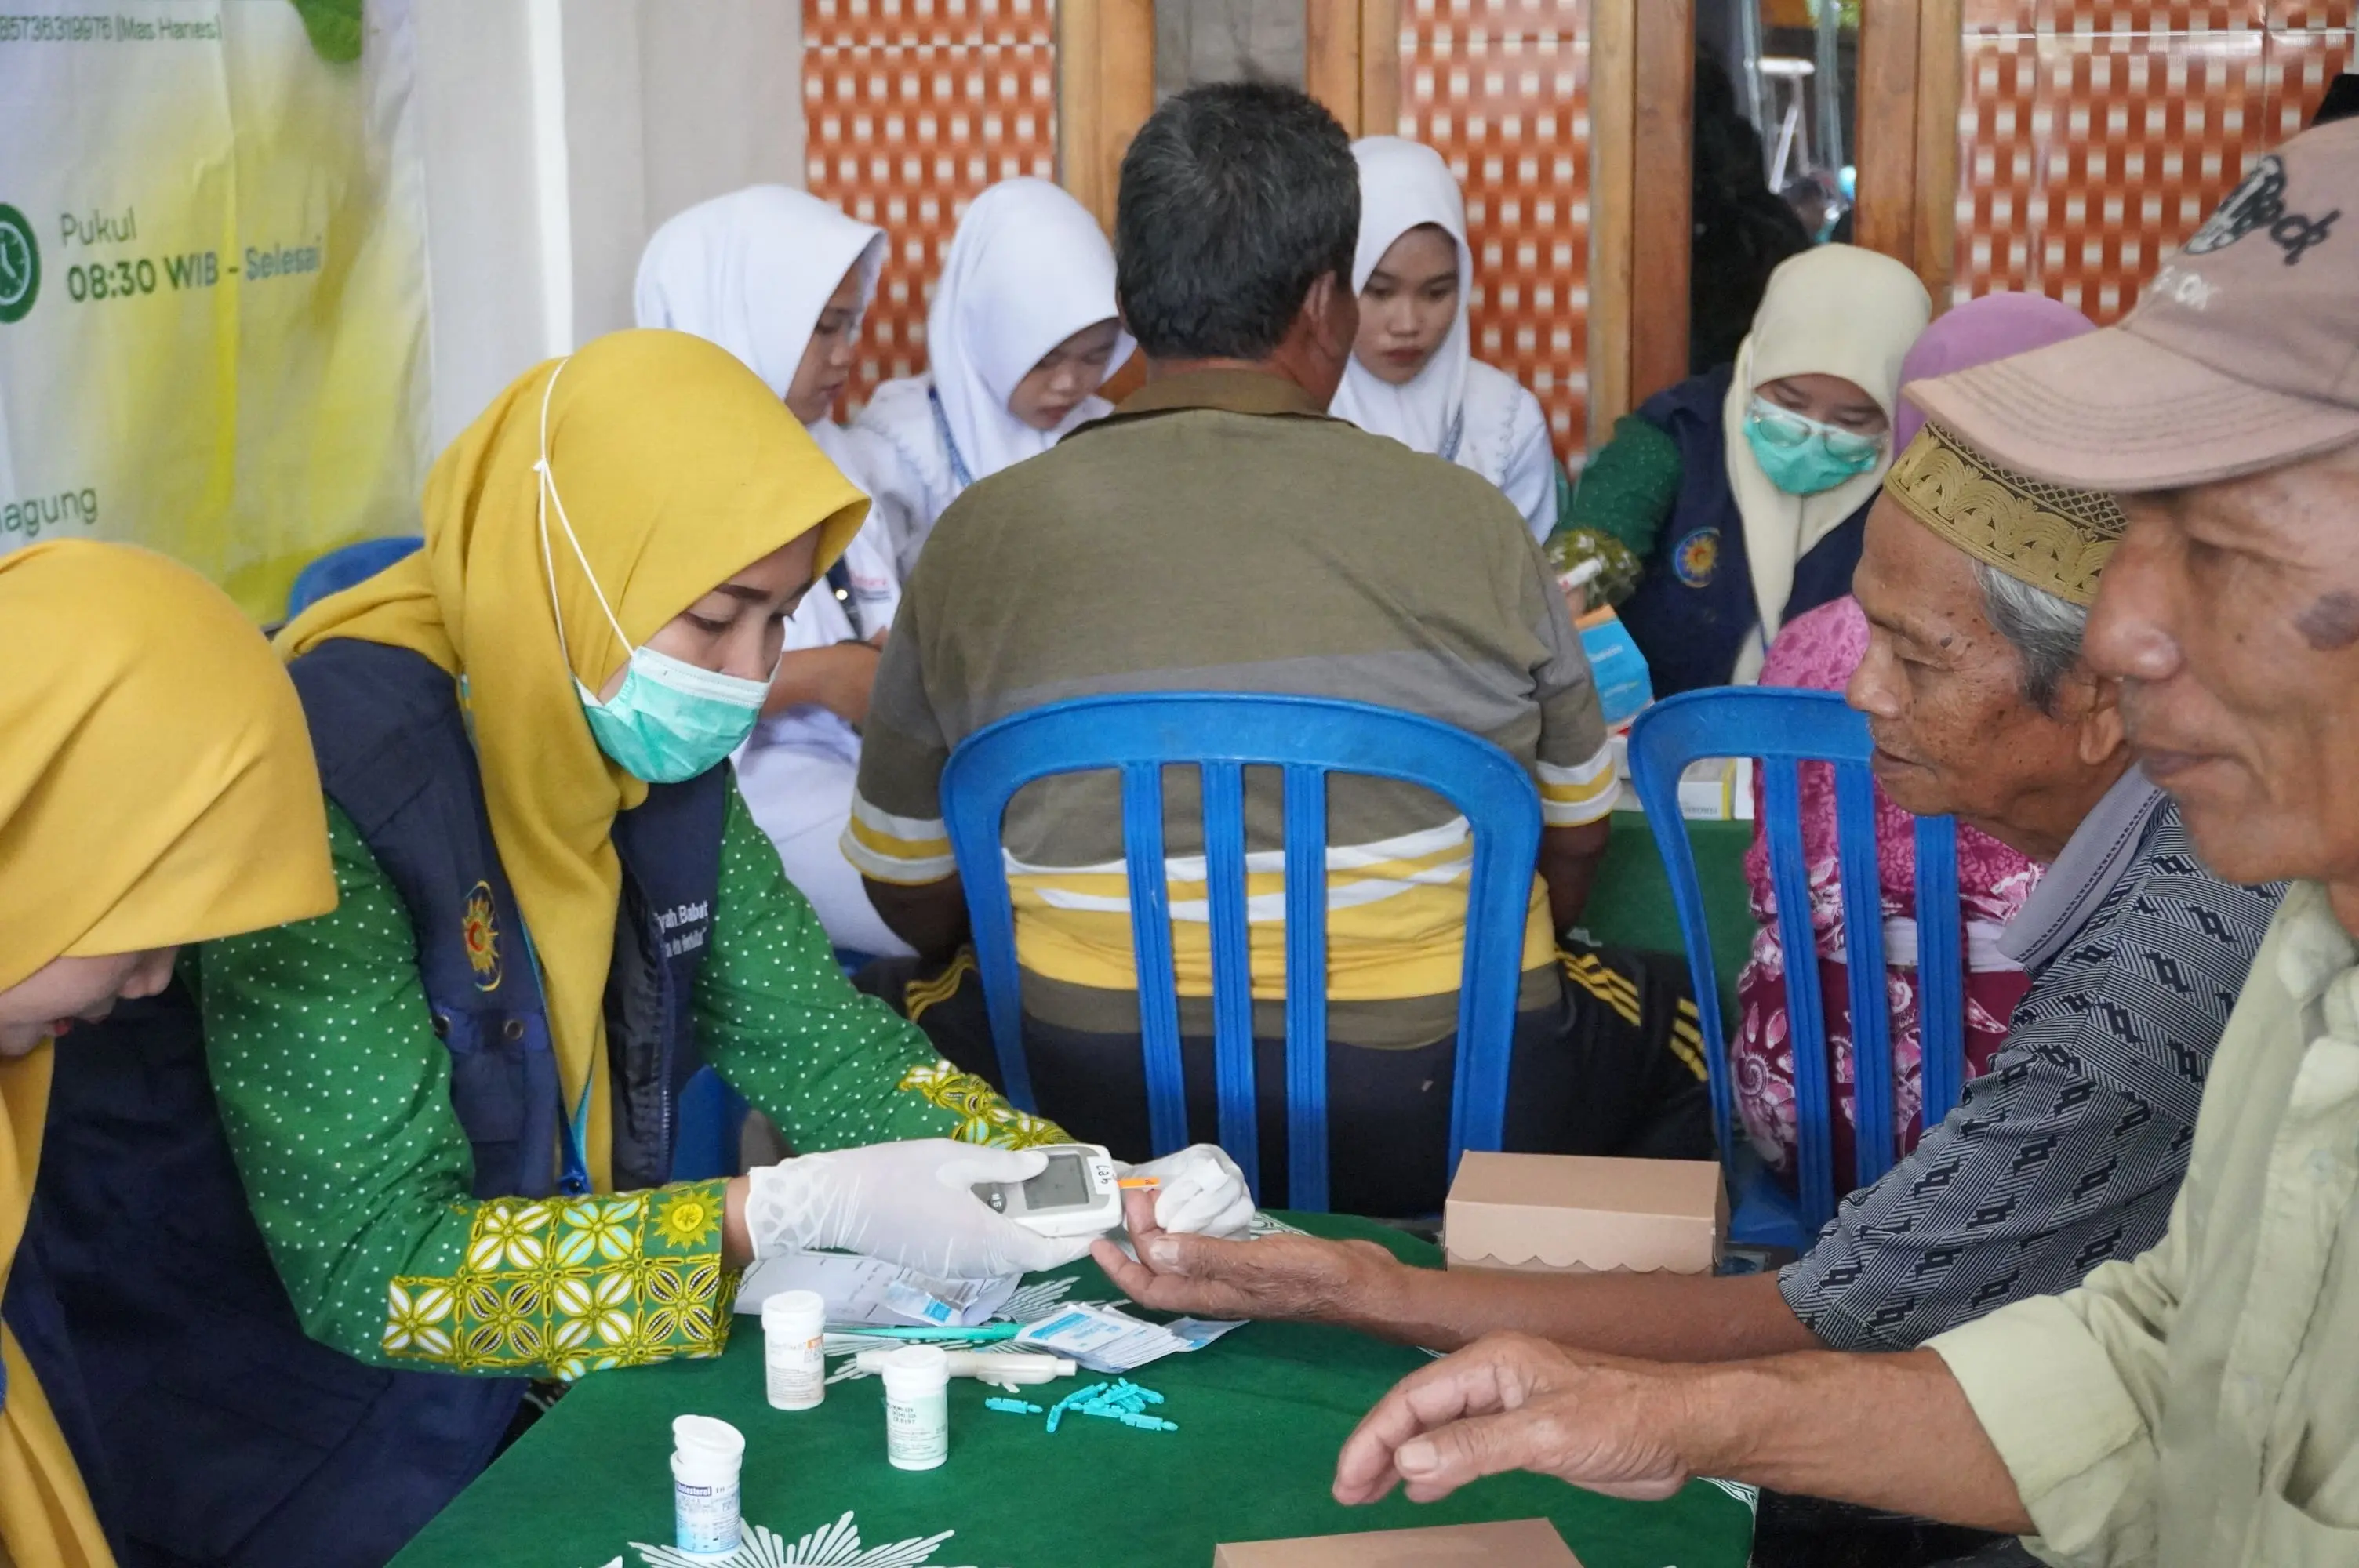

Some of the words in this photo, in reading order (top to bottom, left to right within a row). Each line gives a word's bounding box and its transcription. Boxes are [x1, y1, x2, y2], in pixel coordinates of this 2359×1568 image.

[60, 205, 137, 247] Pukul
[67, 257, 157, 303] 08:30
[162, 250, 220, 290] WIB
[245, 235, 322, 281] Selesai
[0, 487, 99, 539] agung
